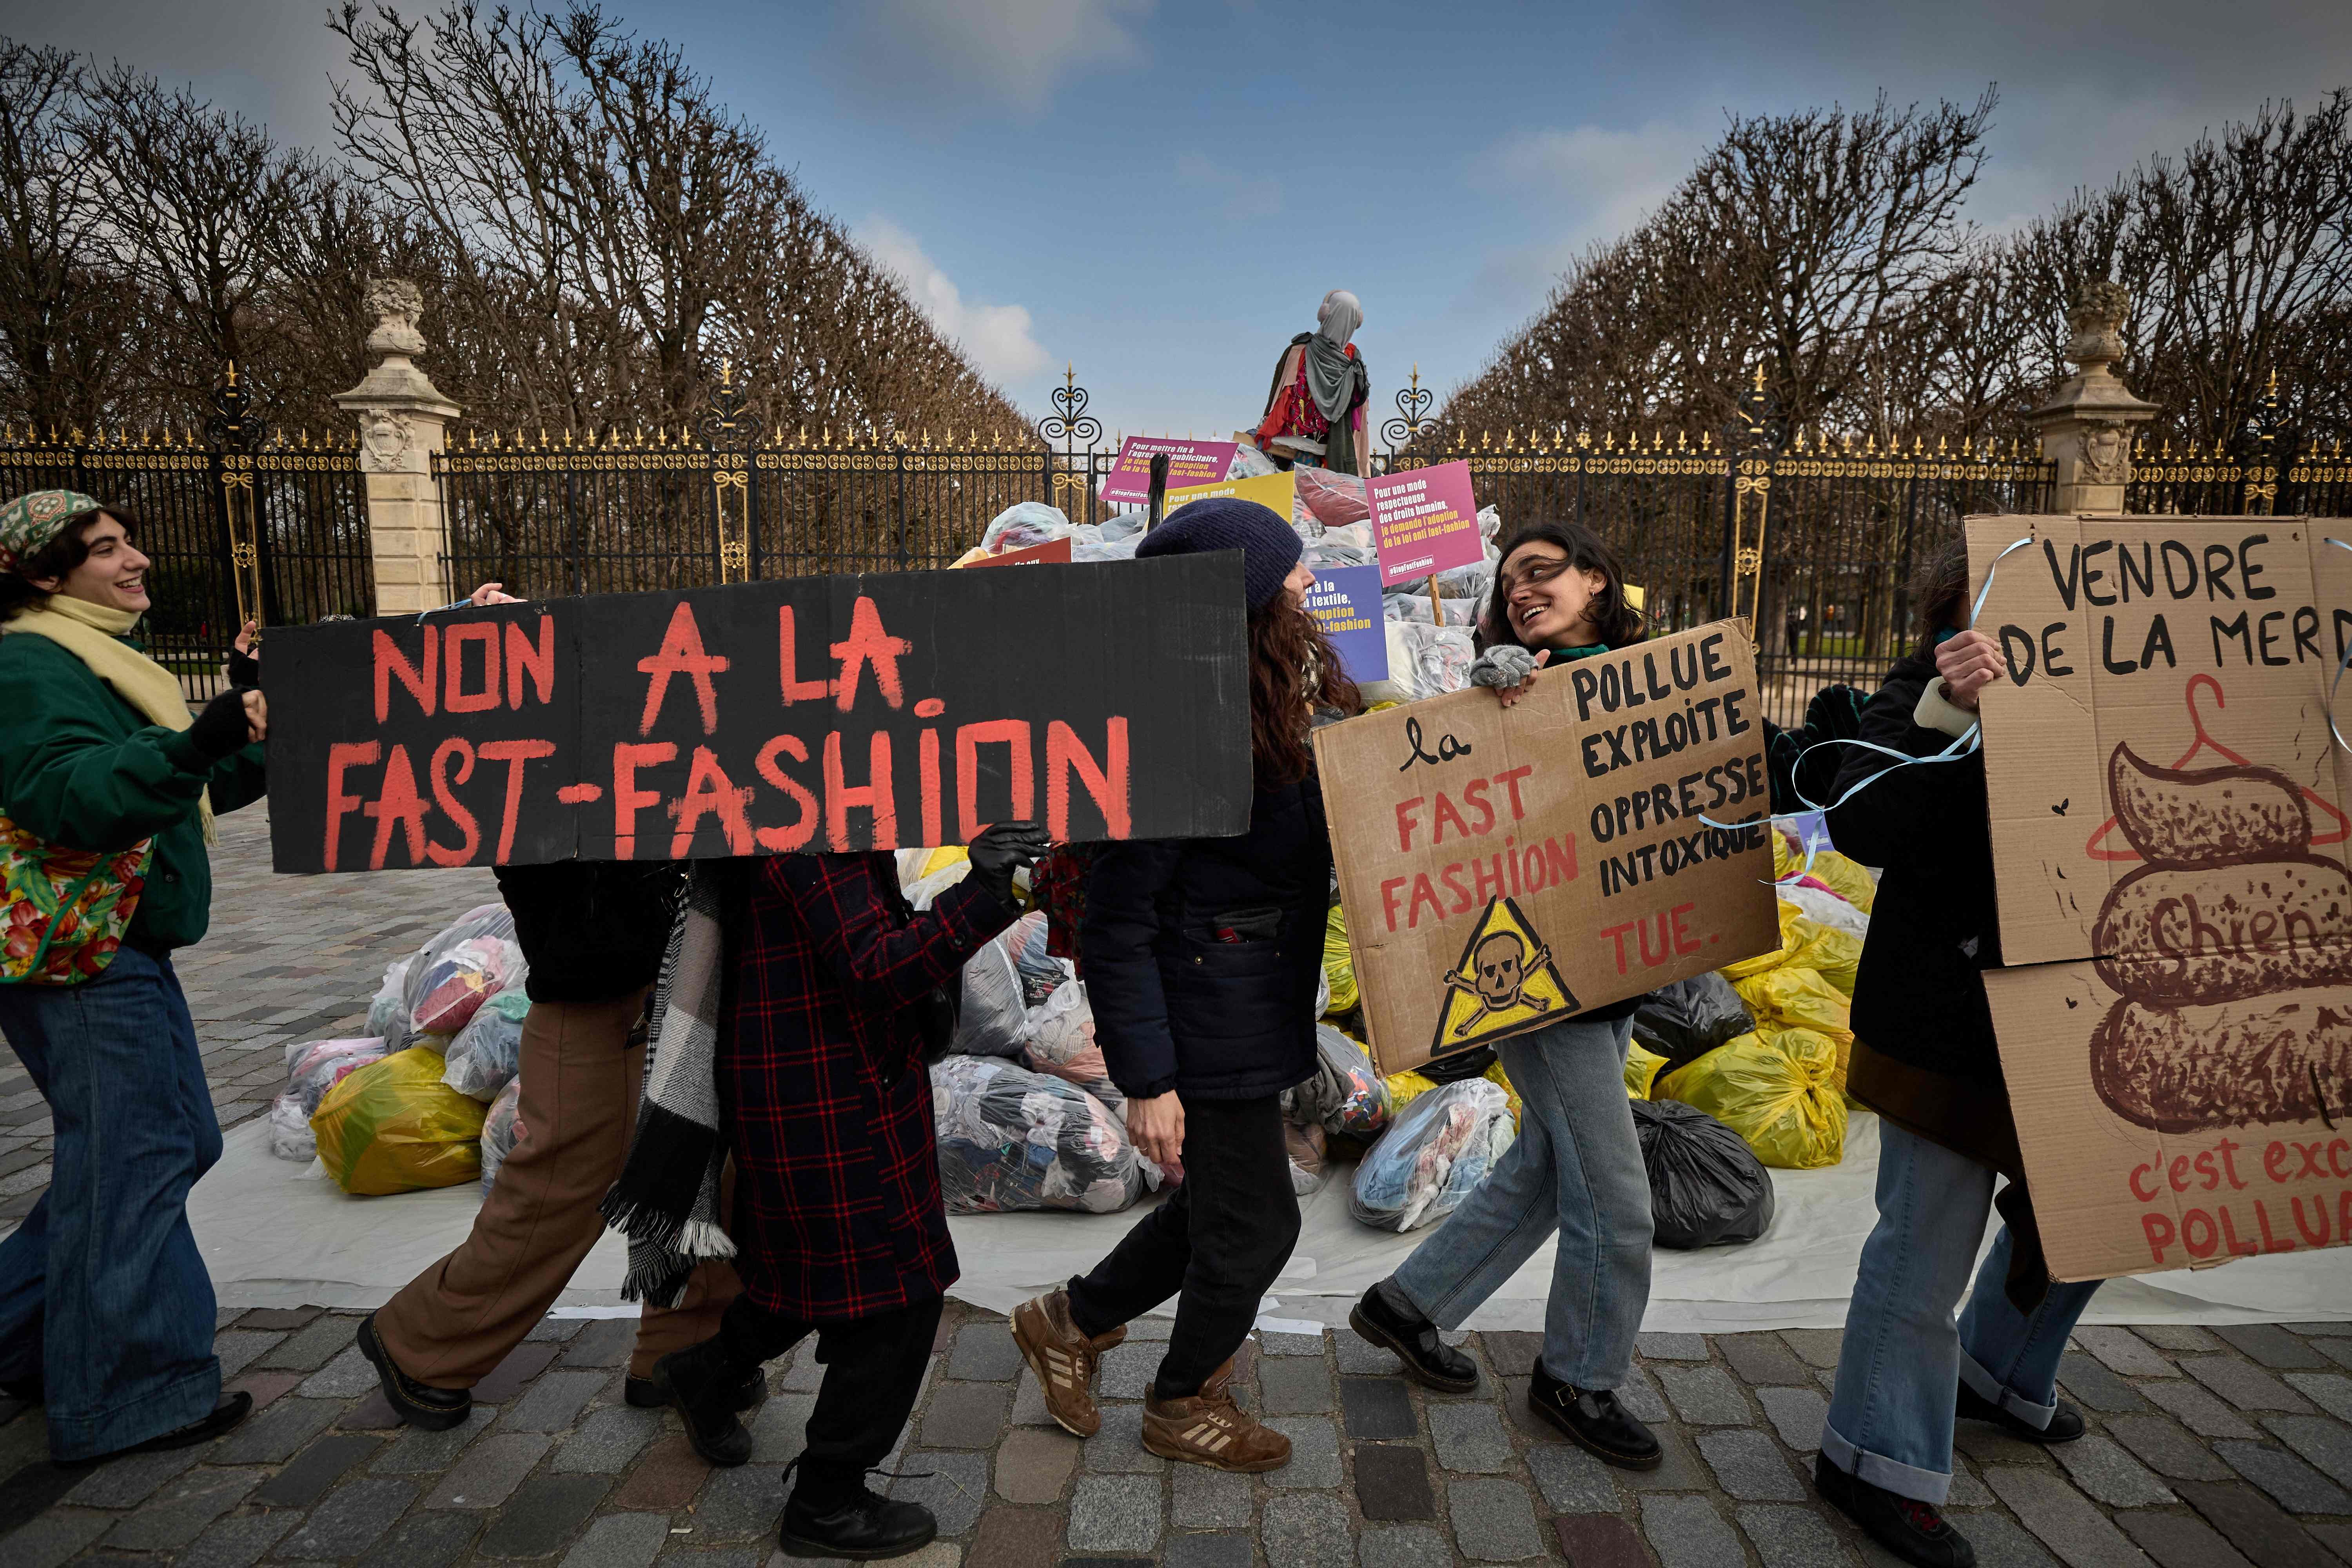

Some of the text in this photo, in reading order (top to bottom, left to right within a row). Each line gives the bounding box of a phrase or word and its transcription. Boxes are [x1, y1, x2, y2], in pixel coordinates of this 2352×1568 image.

[1170, 460, 1209, 470] l'adoption
[1171, 454, 1218, 463] publicitaire,
[1169, 468, 1217, 478] fast-fashion
[1169, 488, 1236, 503] Pour une mode
[1374, 479, 1427, 499] Pour une mode
[1377, 493, 1425, 511] respectueuse
[1379, 500, 1448, 524] des droits humains,
[1381, 510, 1458, 537] je demande l'adoption
[1383, 519, 1470, 548] de la loi anti fast-fashion
[1389, 558, 1433, 575] #StopFastFashion
[2043, 534, 2276, 611] VENDRE
[1314, 581, 1321, 593] à
[1323, 580, 1335, 592] la
[1312, 593, 1351, 608] textile,
[1999, 622, 2074, 687] DE
[2103, 613, 2176, 675] LA
[373, 596, 913, 734] NON A LA
[1572, 633, 1732, 722] POLLUE
[1399, 717, 1472, 772] la
[1395, 765, 1533, 853] FAST
[1590, 753, 1766, 843] OPPRESSE
[1599, 903, 1720, 975] TUE.
[2129, 1138, 2352, 1203] c'est exc
